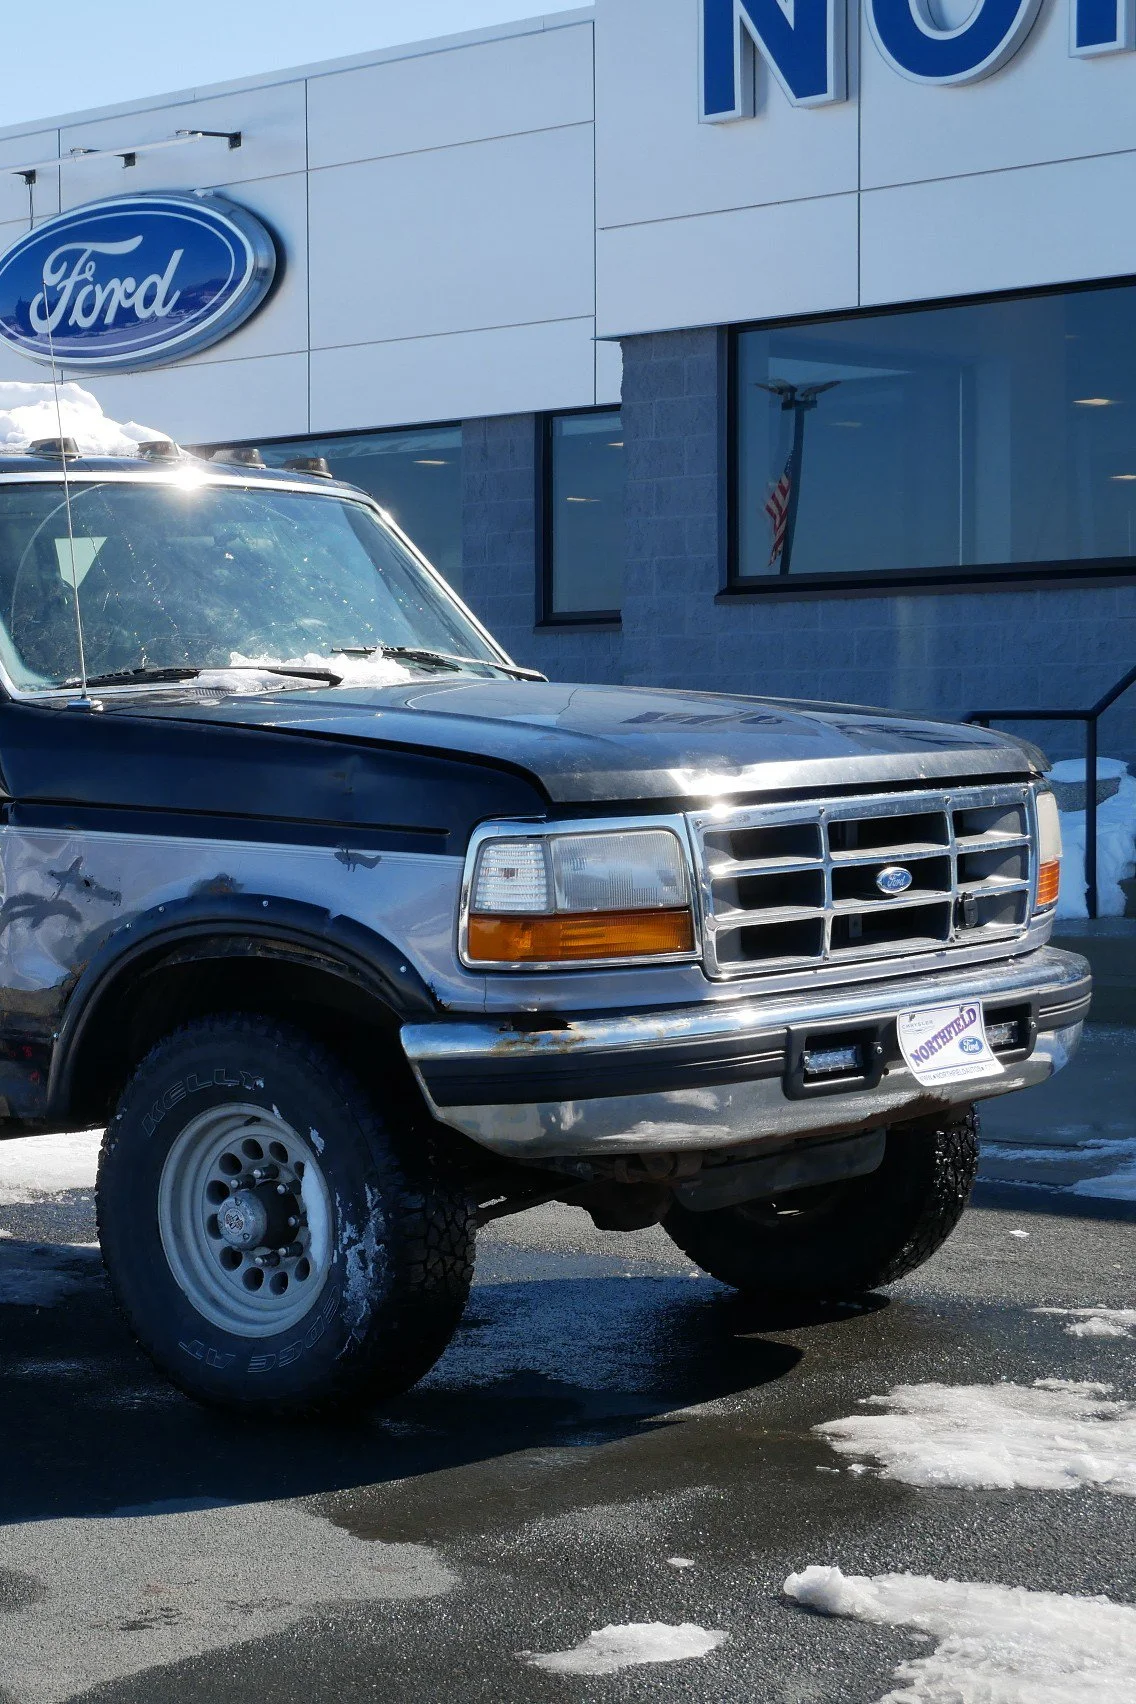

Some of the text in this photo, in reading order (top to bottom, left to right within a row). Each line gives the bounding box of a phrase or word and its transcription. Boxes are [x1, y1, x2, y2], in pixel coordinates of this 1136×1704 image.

[29, 234, 185, 334] Ford
[886, 872, 906, 888] Ford
[909, 1007, 977, 1068] NORTHFIELD
[962, 1038, 981, 1052] Ford
[142, 1067, 265, 1137] KELLY
[178, 1339, 237, 1370] AT
[247, 1285, 341, 1374] EDGE
